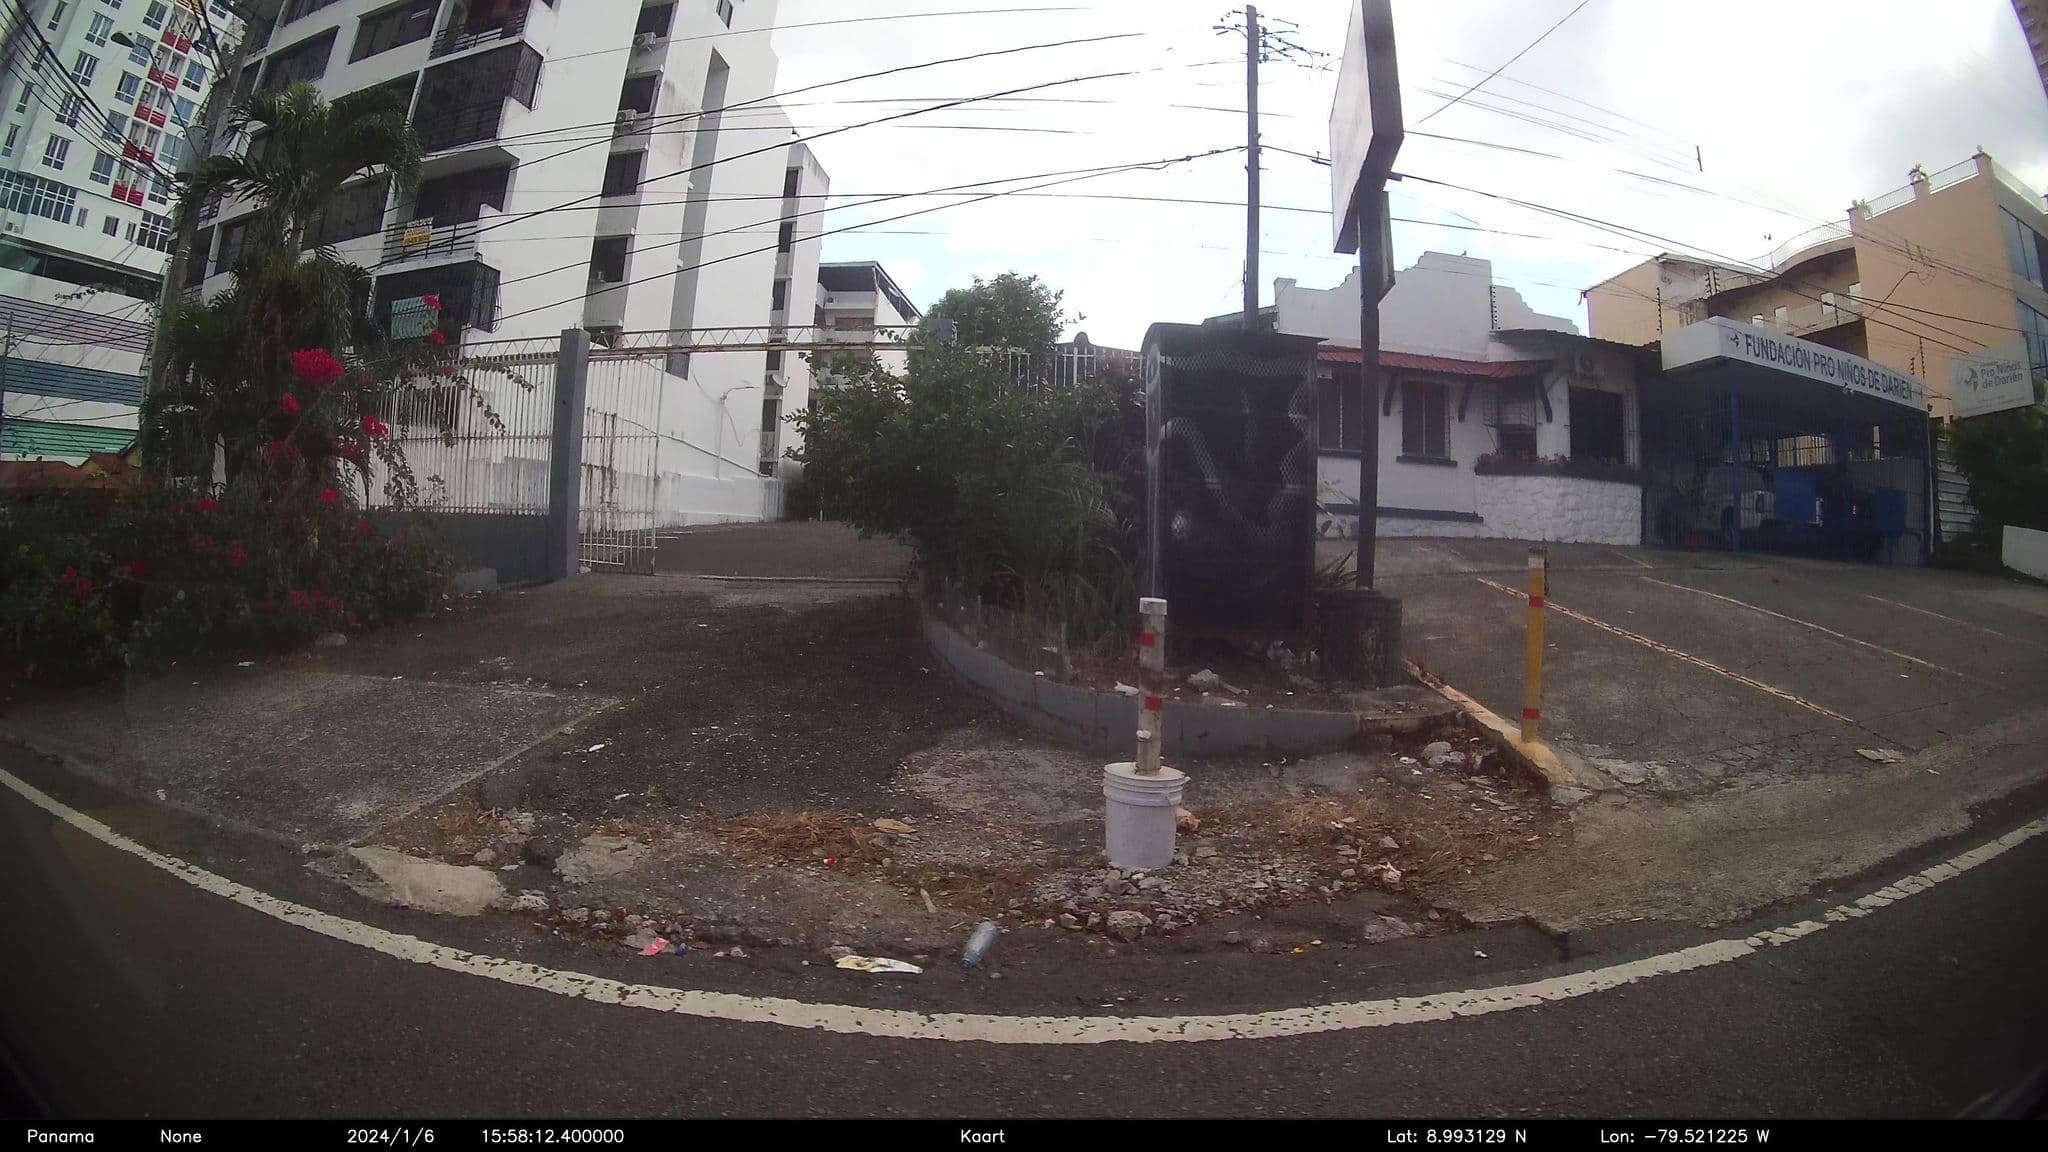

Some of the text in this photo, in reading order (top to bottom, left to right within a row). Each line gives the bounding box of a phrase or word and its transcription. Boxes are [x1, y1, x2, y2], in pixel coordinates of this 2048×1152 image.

[1745, 334, 1811, 371] FUNDACIÓN
[1813, 351, 1835, 377] PRO
[1837, 359, 1866, 387] NIÑOS
[1868, 369, 1881, 391] DE
[1981, 368, 1995, 379] Pro
[1983, 378, 1993, 389] de
